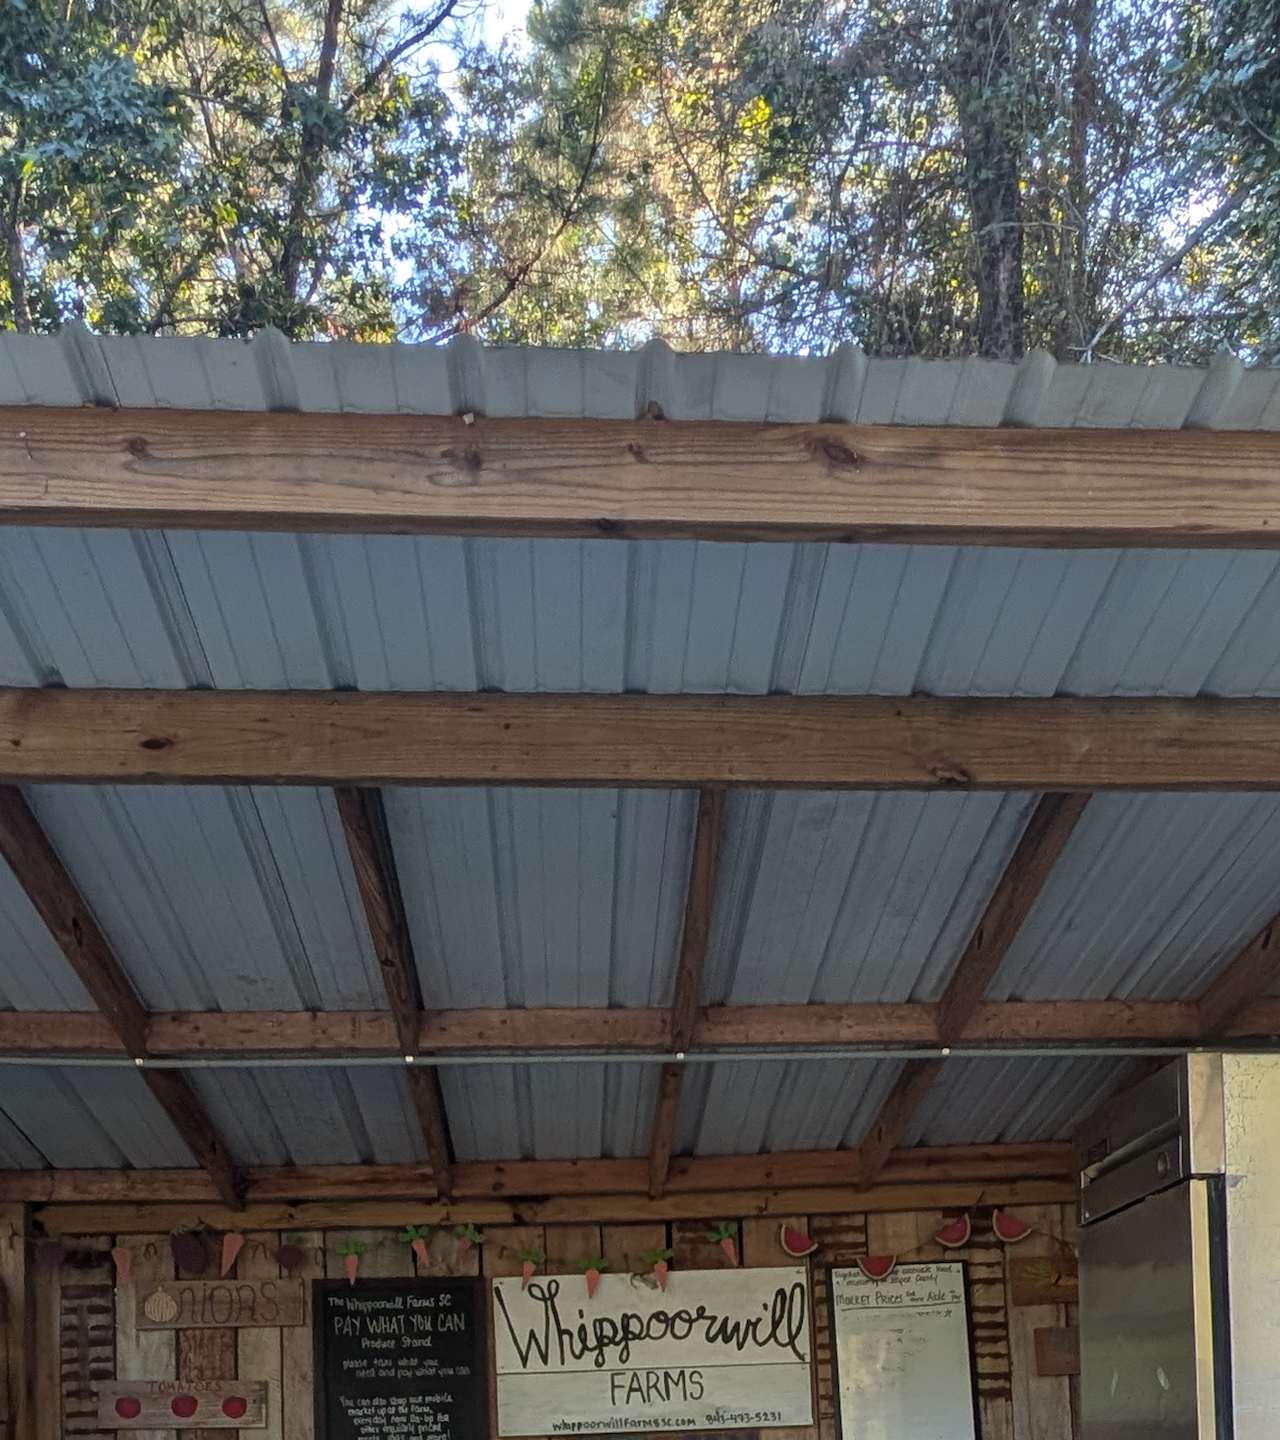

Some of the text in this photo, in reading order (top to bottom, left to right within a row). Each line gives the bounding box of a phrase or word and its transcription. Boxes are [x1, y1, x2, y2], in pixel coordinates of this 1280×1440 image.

[328, 1296, 344, 1307] The
[439, 1294, 452, 1306] SC
[334, 1313, 465, 1336] PAY WHAT YOU CAN
[494, 1279, 807, 1368] Whippoorwill
[401, 1336, 432, 1348] Stand
[147, 1381, 223, 1393] TOMATOES
[610, 1370, 705, 1405] FARMS
